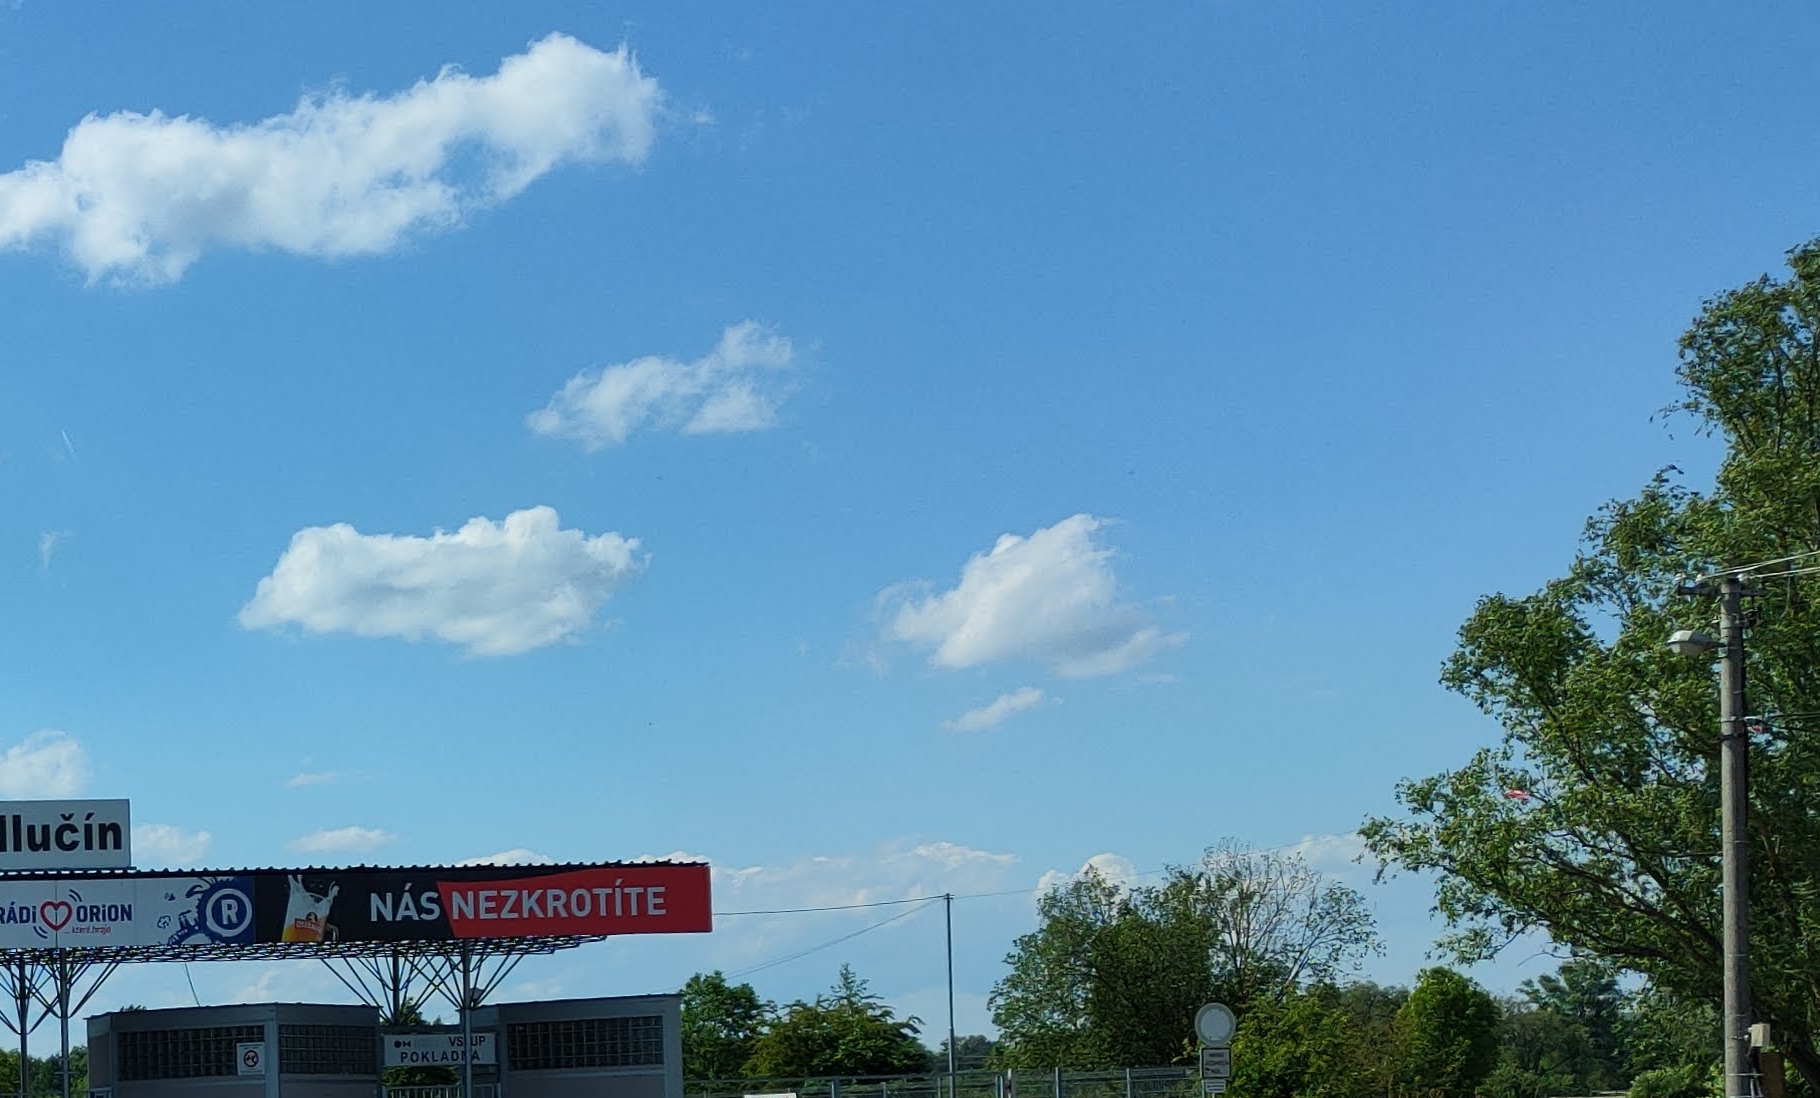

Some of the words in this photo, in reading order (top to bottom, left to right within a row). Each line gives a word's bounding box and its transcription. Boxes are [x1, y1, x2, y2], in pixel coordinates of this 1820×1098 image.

[370, 883, 441, 921] NÁS
[452, 879, 667, 920] NEZKROTÍTE
[449, 1036, 486, 1047] VSUP
